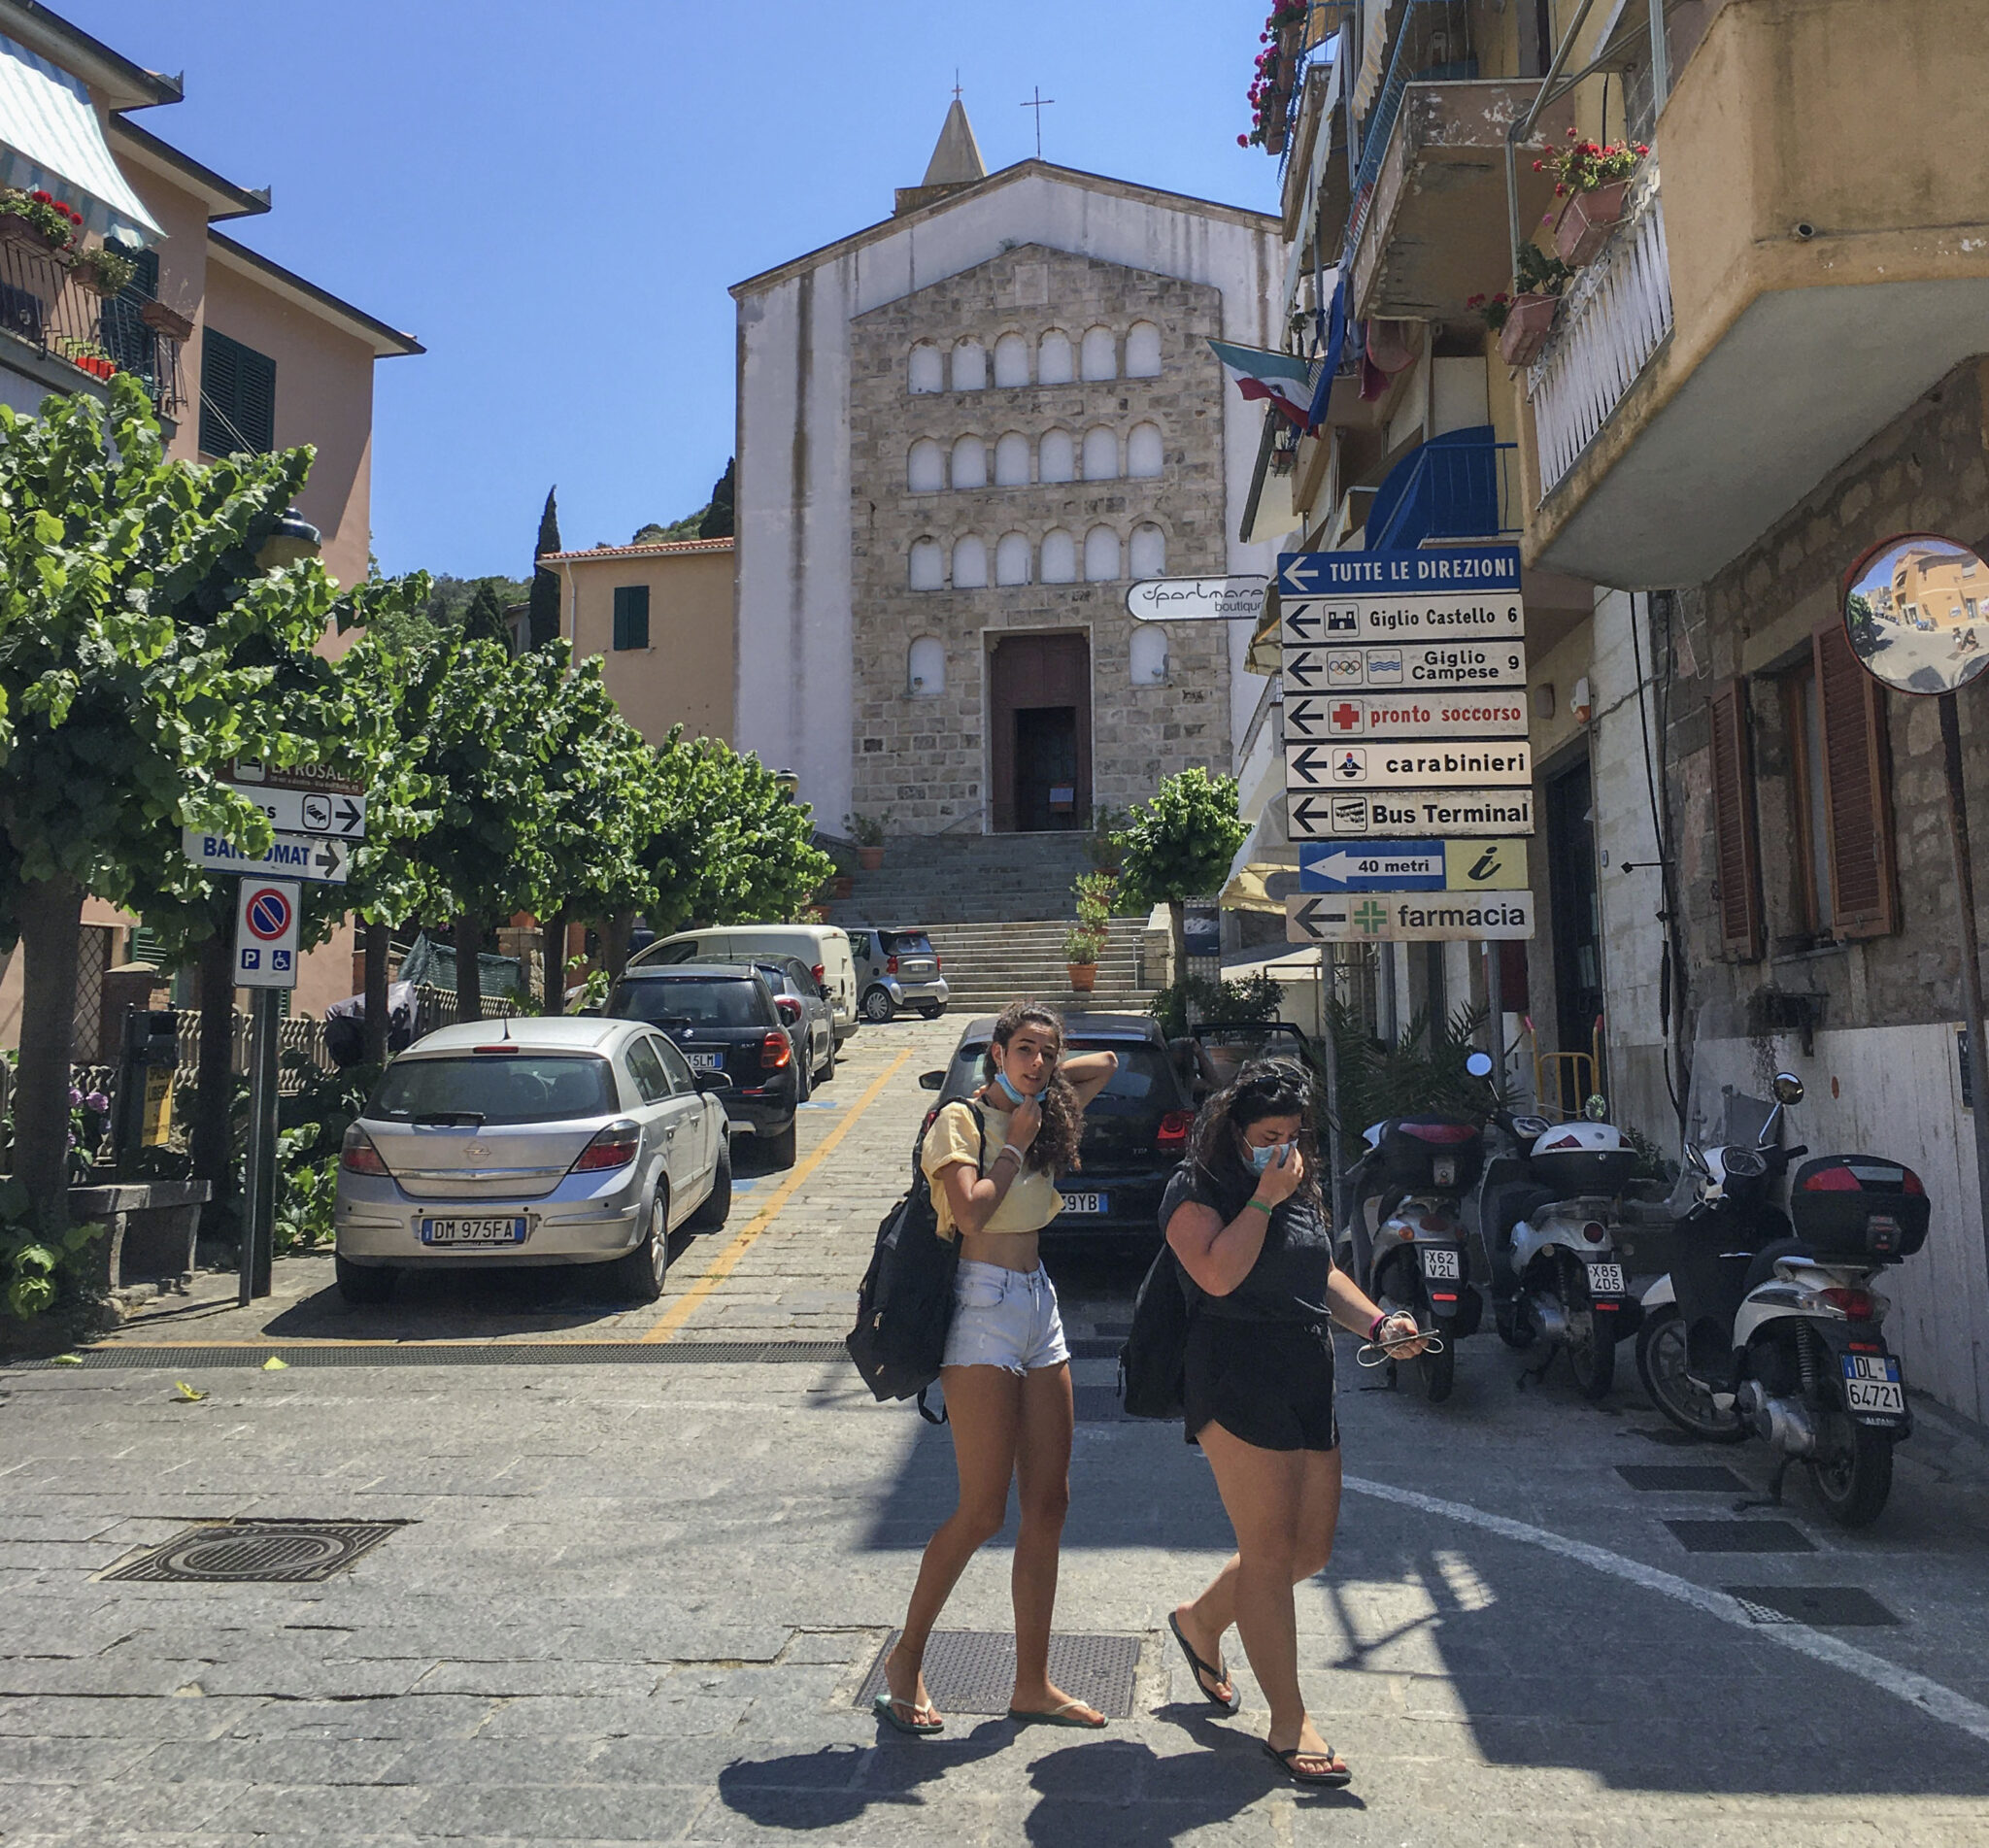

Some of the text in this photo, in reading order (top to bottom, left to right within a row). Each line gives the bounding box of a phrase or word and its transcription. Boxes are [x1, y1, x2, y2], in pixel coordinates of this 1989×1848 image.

[1330, 557, 1515, 582] TUTTE LE DIREZIONI
[1369, 607, 1518, 629] Giglio Castello 6
[1424, 650, 1486, 667] Giglio
[1507, 655, 1520, 670] 9
[1411, 664, 1500, 682] Campese
[1370, 705, 1522, 727] pronto soccorso
[1386, 753, 1525, 773] carabinieri
[1372, 802, 1529, 824] Bus Terminal
[203, 836, 311, 866] BANMAT
[1359, 858, 1430, 873] 40 metri
[1398, 902, 1526, 927] farmacia
[245, 952, 256, 967] P
[434, 1221, 455, 1239] DM
[461, 1220, 513, 1238] 975FA
[1429, 1251, 1455, 1264] X62
[1429, 1263, 1455, 1278] V2L
[1592, 1265, 1618, 1278] X85
[1595, 1278, 1621, 1291] 4D5
[1854, 1357, 1877, 1379] DL
[1848, 1383, 1901, 1408] 64721
